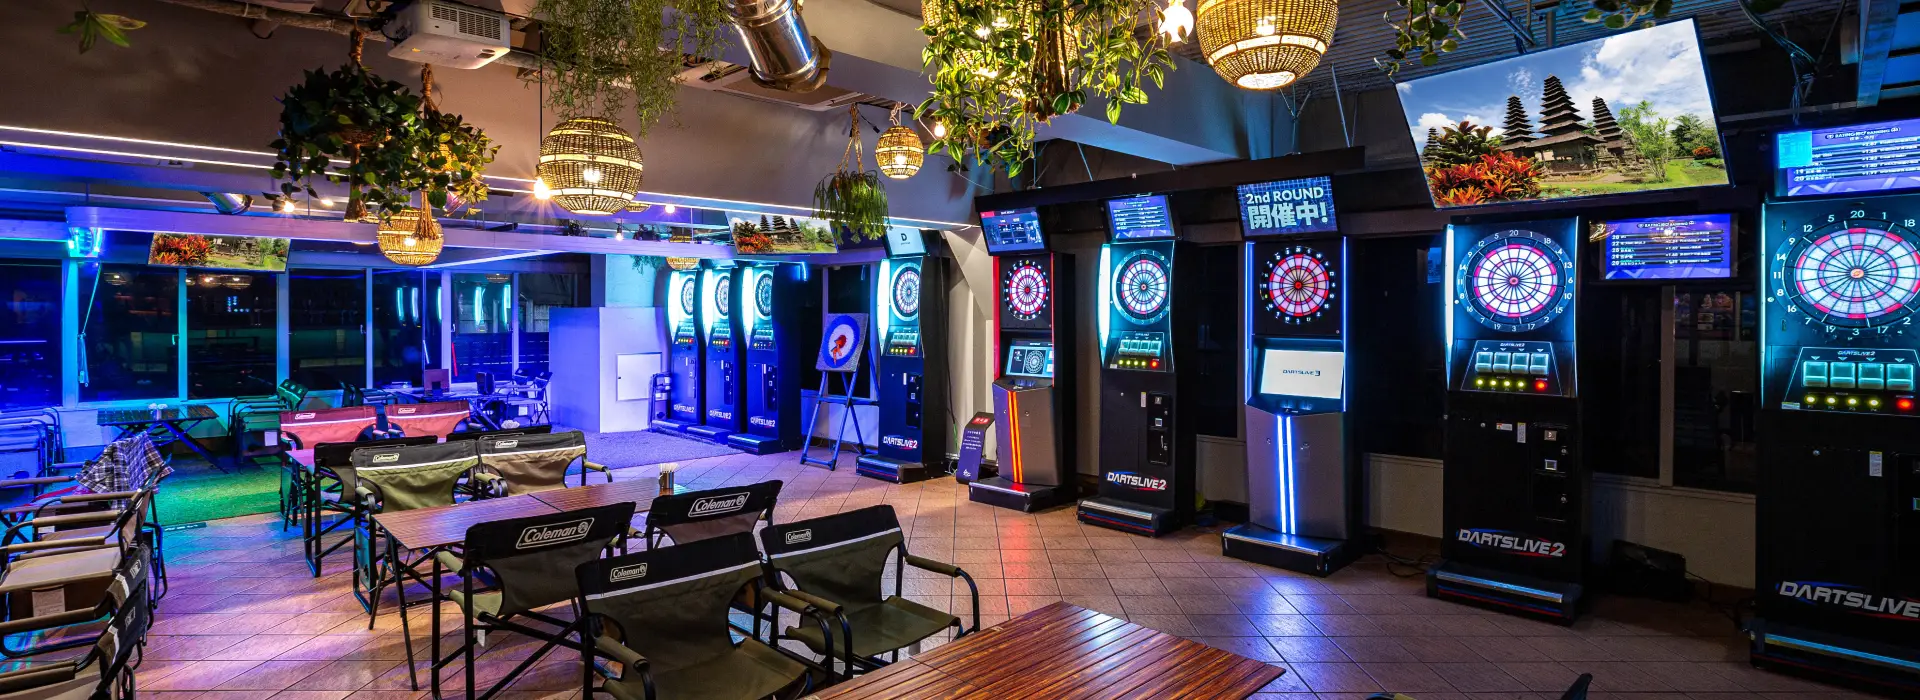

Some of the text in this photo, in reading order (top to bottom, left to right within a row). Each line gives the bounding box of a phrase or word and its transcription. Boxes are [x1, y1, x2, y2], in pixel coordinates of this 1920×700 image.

[1246, 187, 1324, 204] 2nd ROUND
[1248, 201, 1328, 230] 開催中!
[1850, 210, 1865, 218] 20
[710, 410, 731, 419] DARTSLIVE2
[750, 417, 775, 427] DARTSLIVE2
[883, 436, 918, 448] DARTSLIVE2
[1107, 472, 1167, 490] DARTSLIVE2
[695, 498, 736, 512] Coleman
[524, 526, 576, 543] Coleman
[1458, 529, 1565, 557] DARTSLIVE2
[613, 567, 640, 579] Coleman
[1780, 581, 1920, 618] DARTSLIVE
